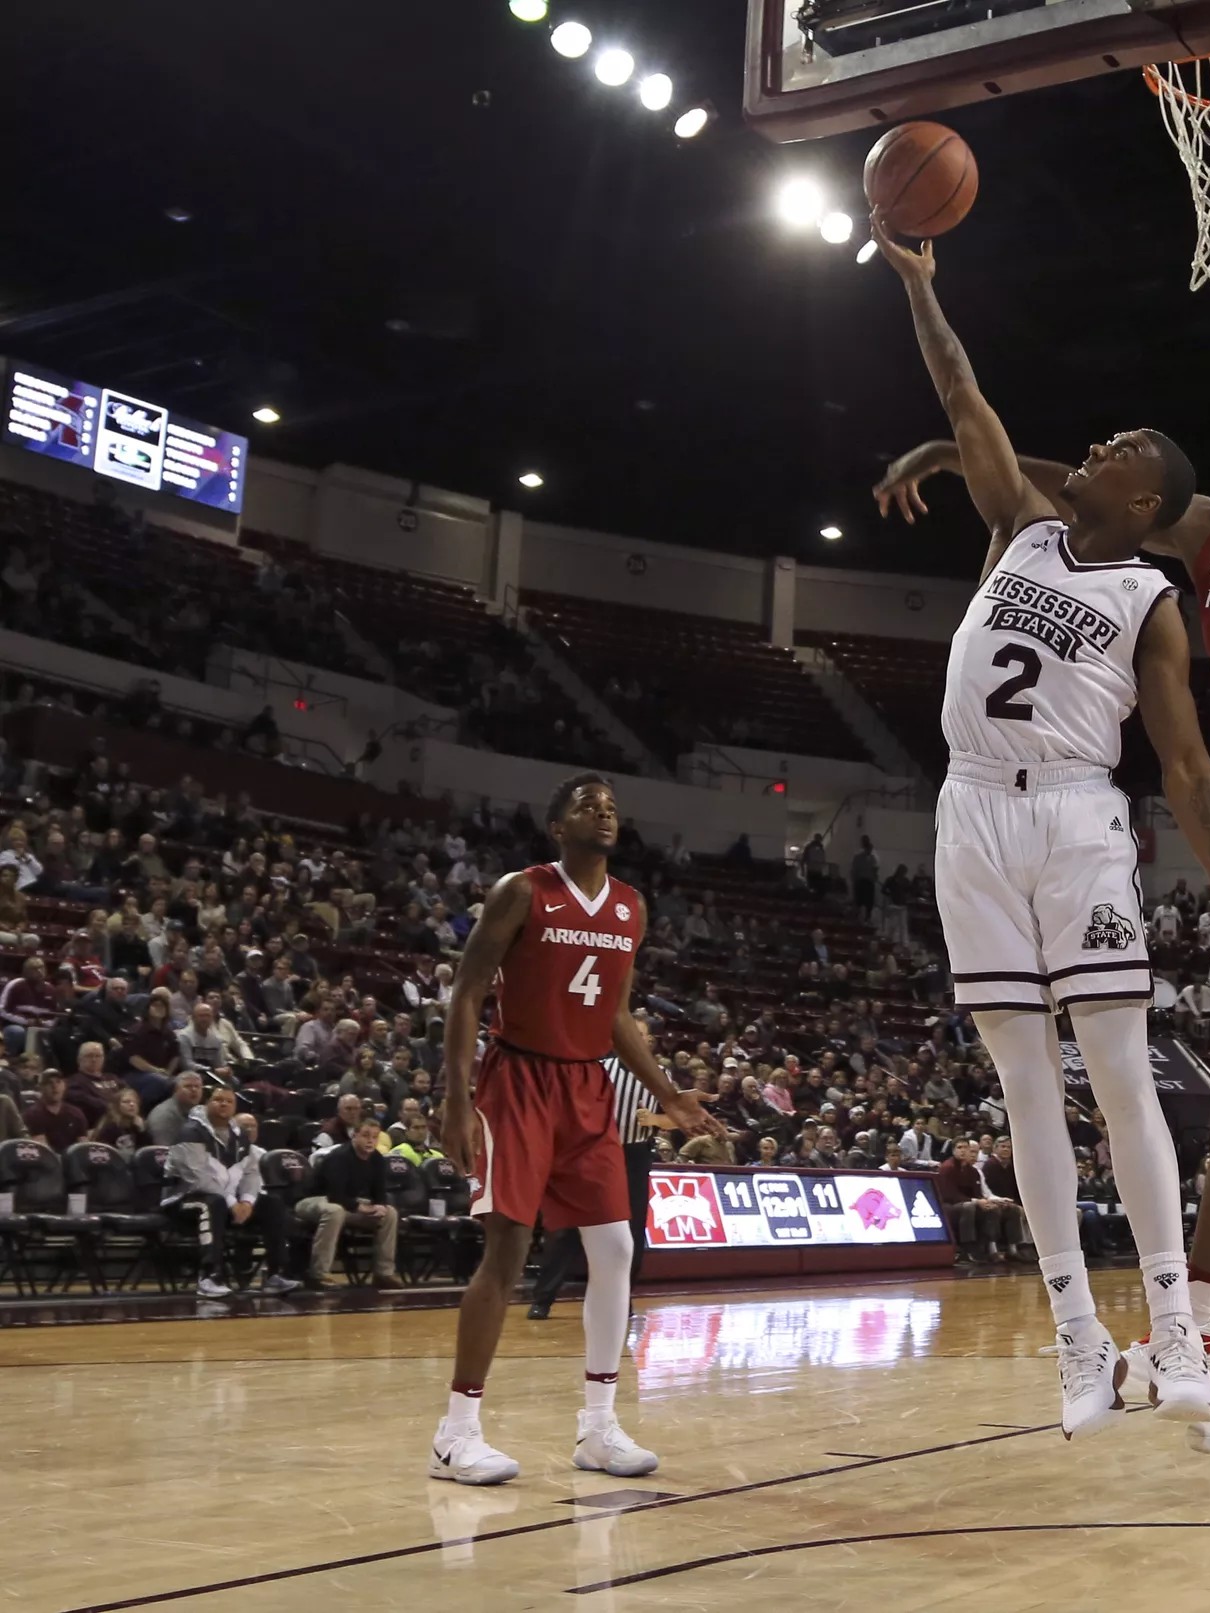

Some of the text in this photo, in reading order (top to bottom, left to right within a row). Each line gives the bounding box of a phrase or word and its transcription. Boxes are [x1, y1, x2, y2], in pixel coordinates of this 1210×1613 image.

[988, 574, 1119, 650] MISSISSIPPI
[1001, 612, 1067, 651] STATE
[986, 643, 1042, 721] 2
[541, 928, 632, 952] ARKANSAS
[1090, 931, 1118, 940] STATE
[568, 955, 602, 1006] 4
[723, 1182, 752, 1208] 11
[812, 1184, 838, 1208] 11
